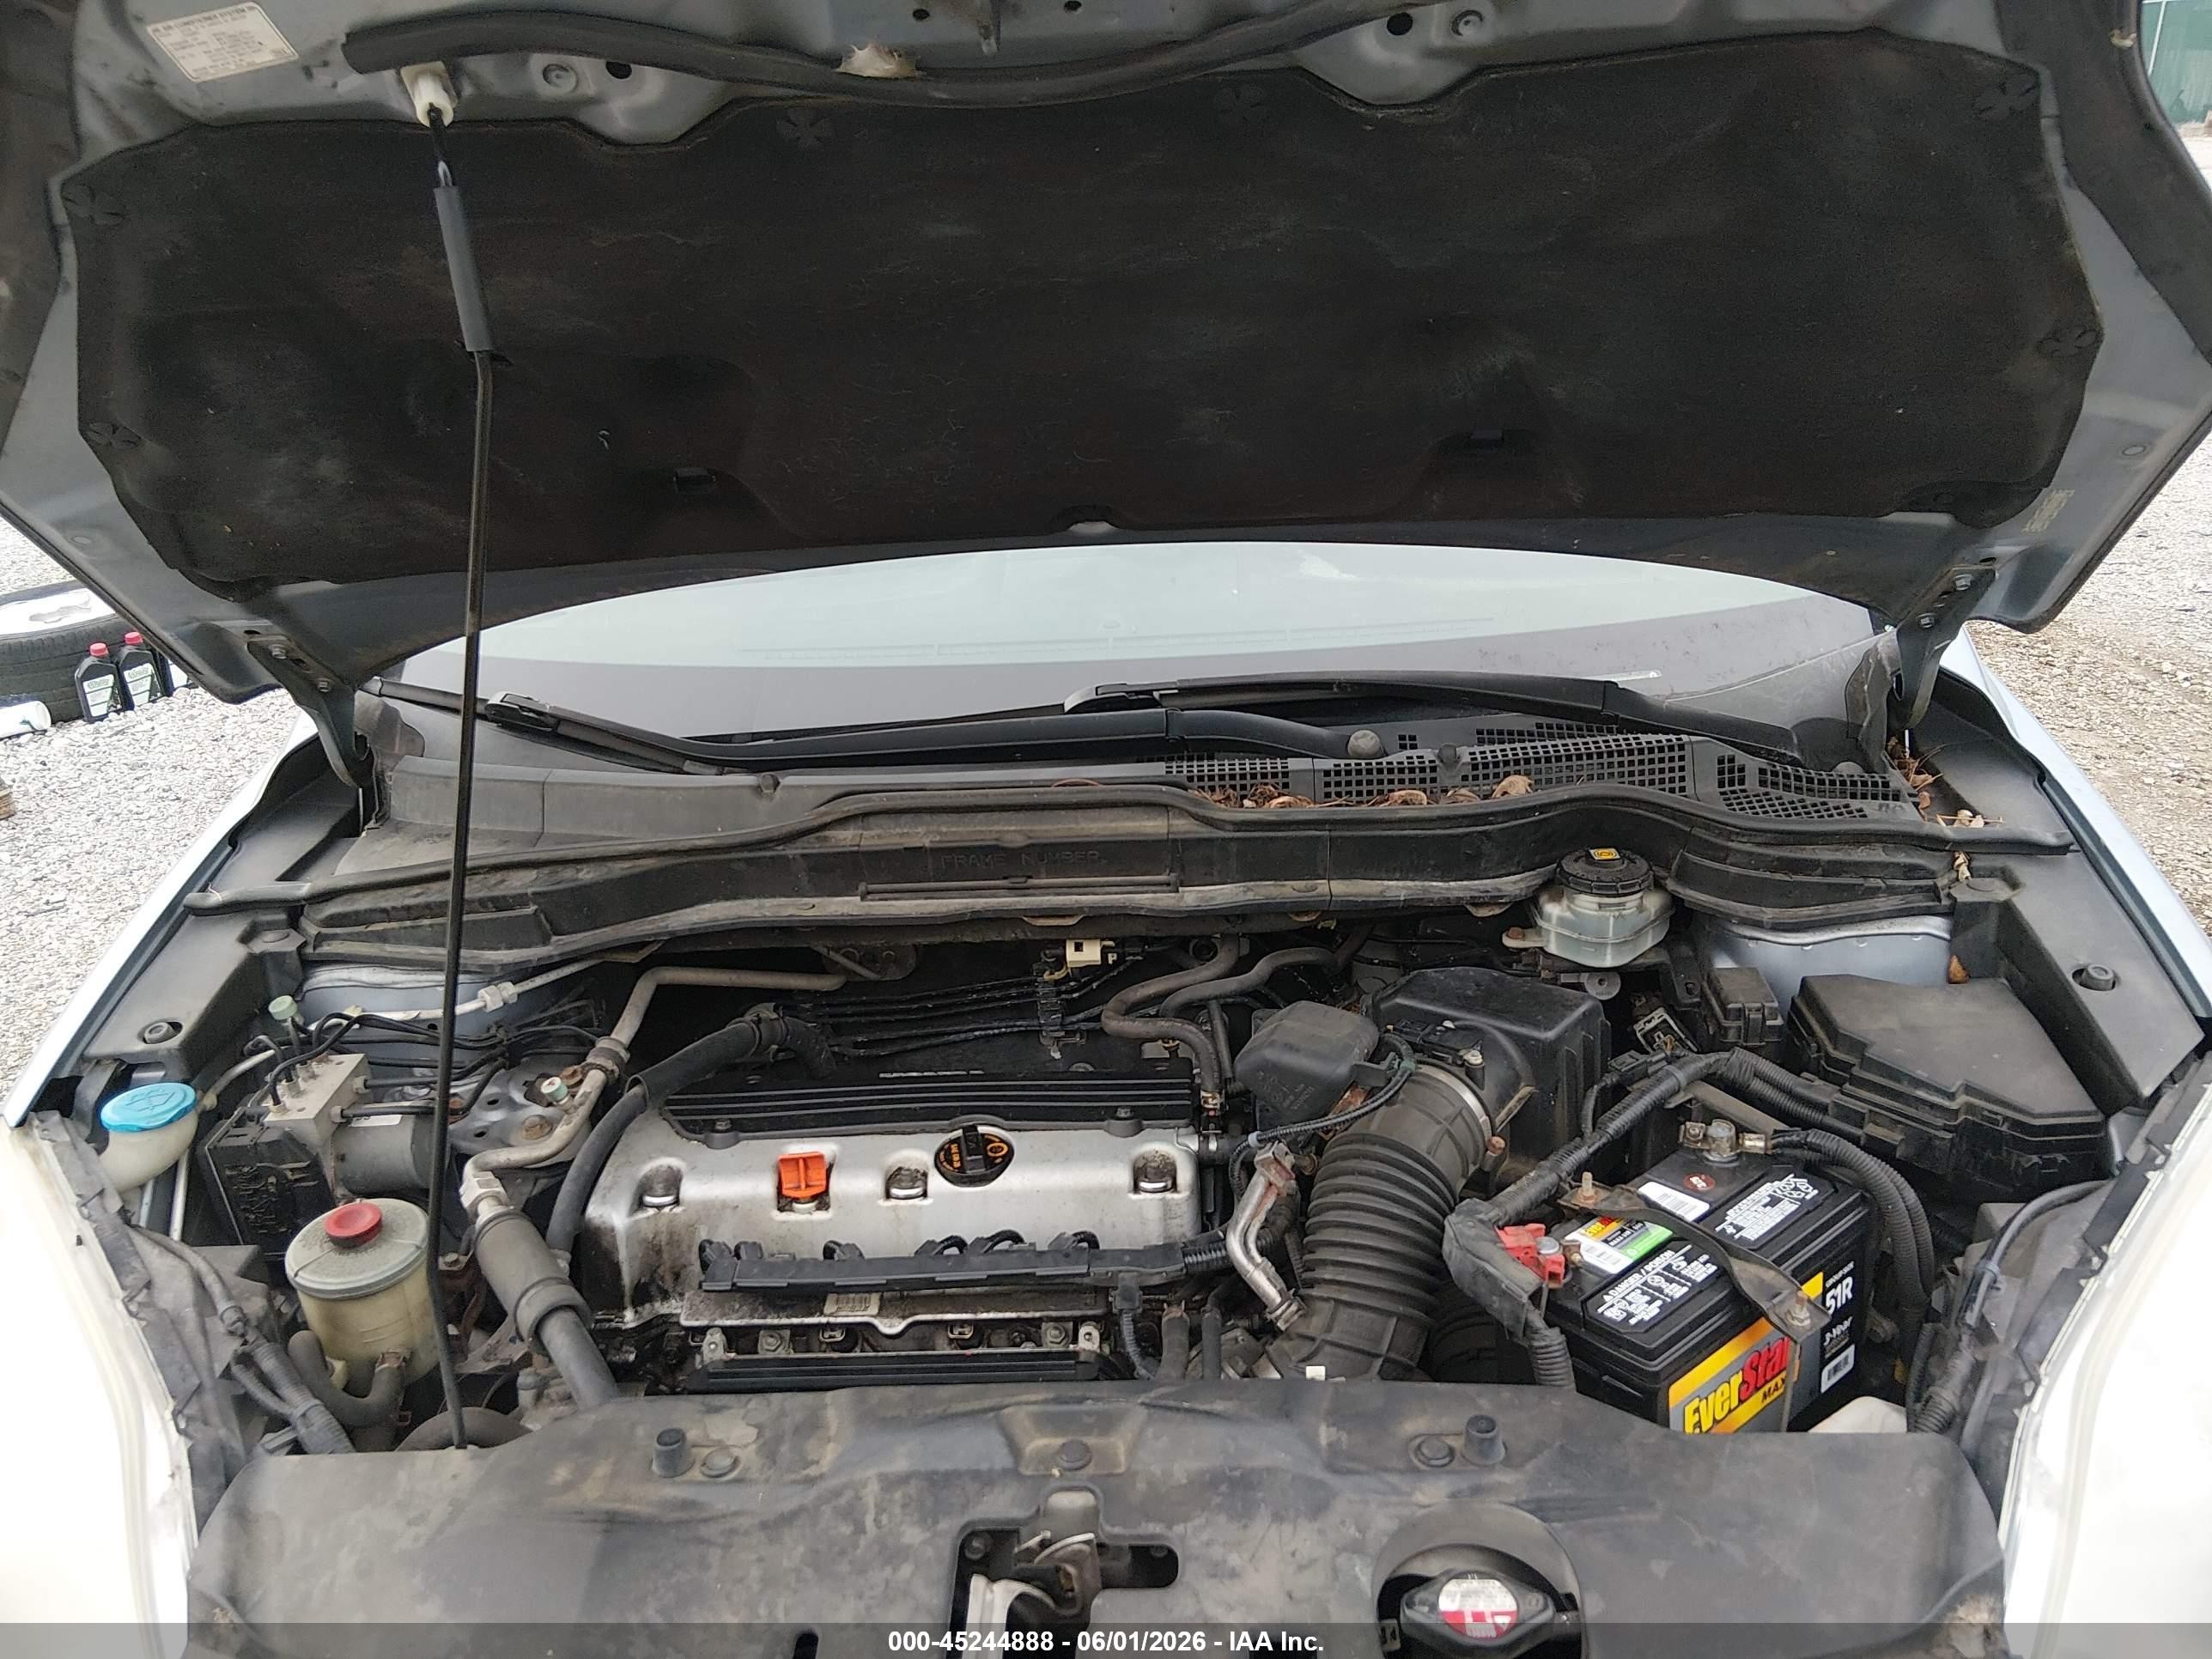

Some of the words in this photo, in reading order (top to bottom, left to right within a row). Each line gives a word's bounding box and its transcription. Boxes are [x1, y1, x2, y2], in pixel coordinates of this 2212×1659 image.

[941, 854, 1006, 868] FRAME
[1022, 850, 1100, 866] NUMBER
[1608, 1273, 1644, 1295] DANGER
[1644, 1249, 1675, 1272] POISON
[1826, 1276, 1853, 1316] 51R
